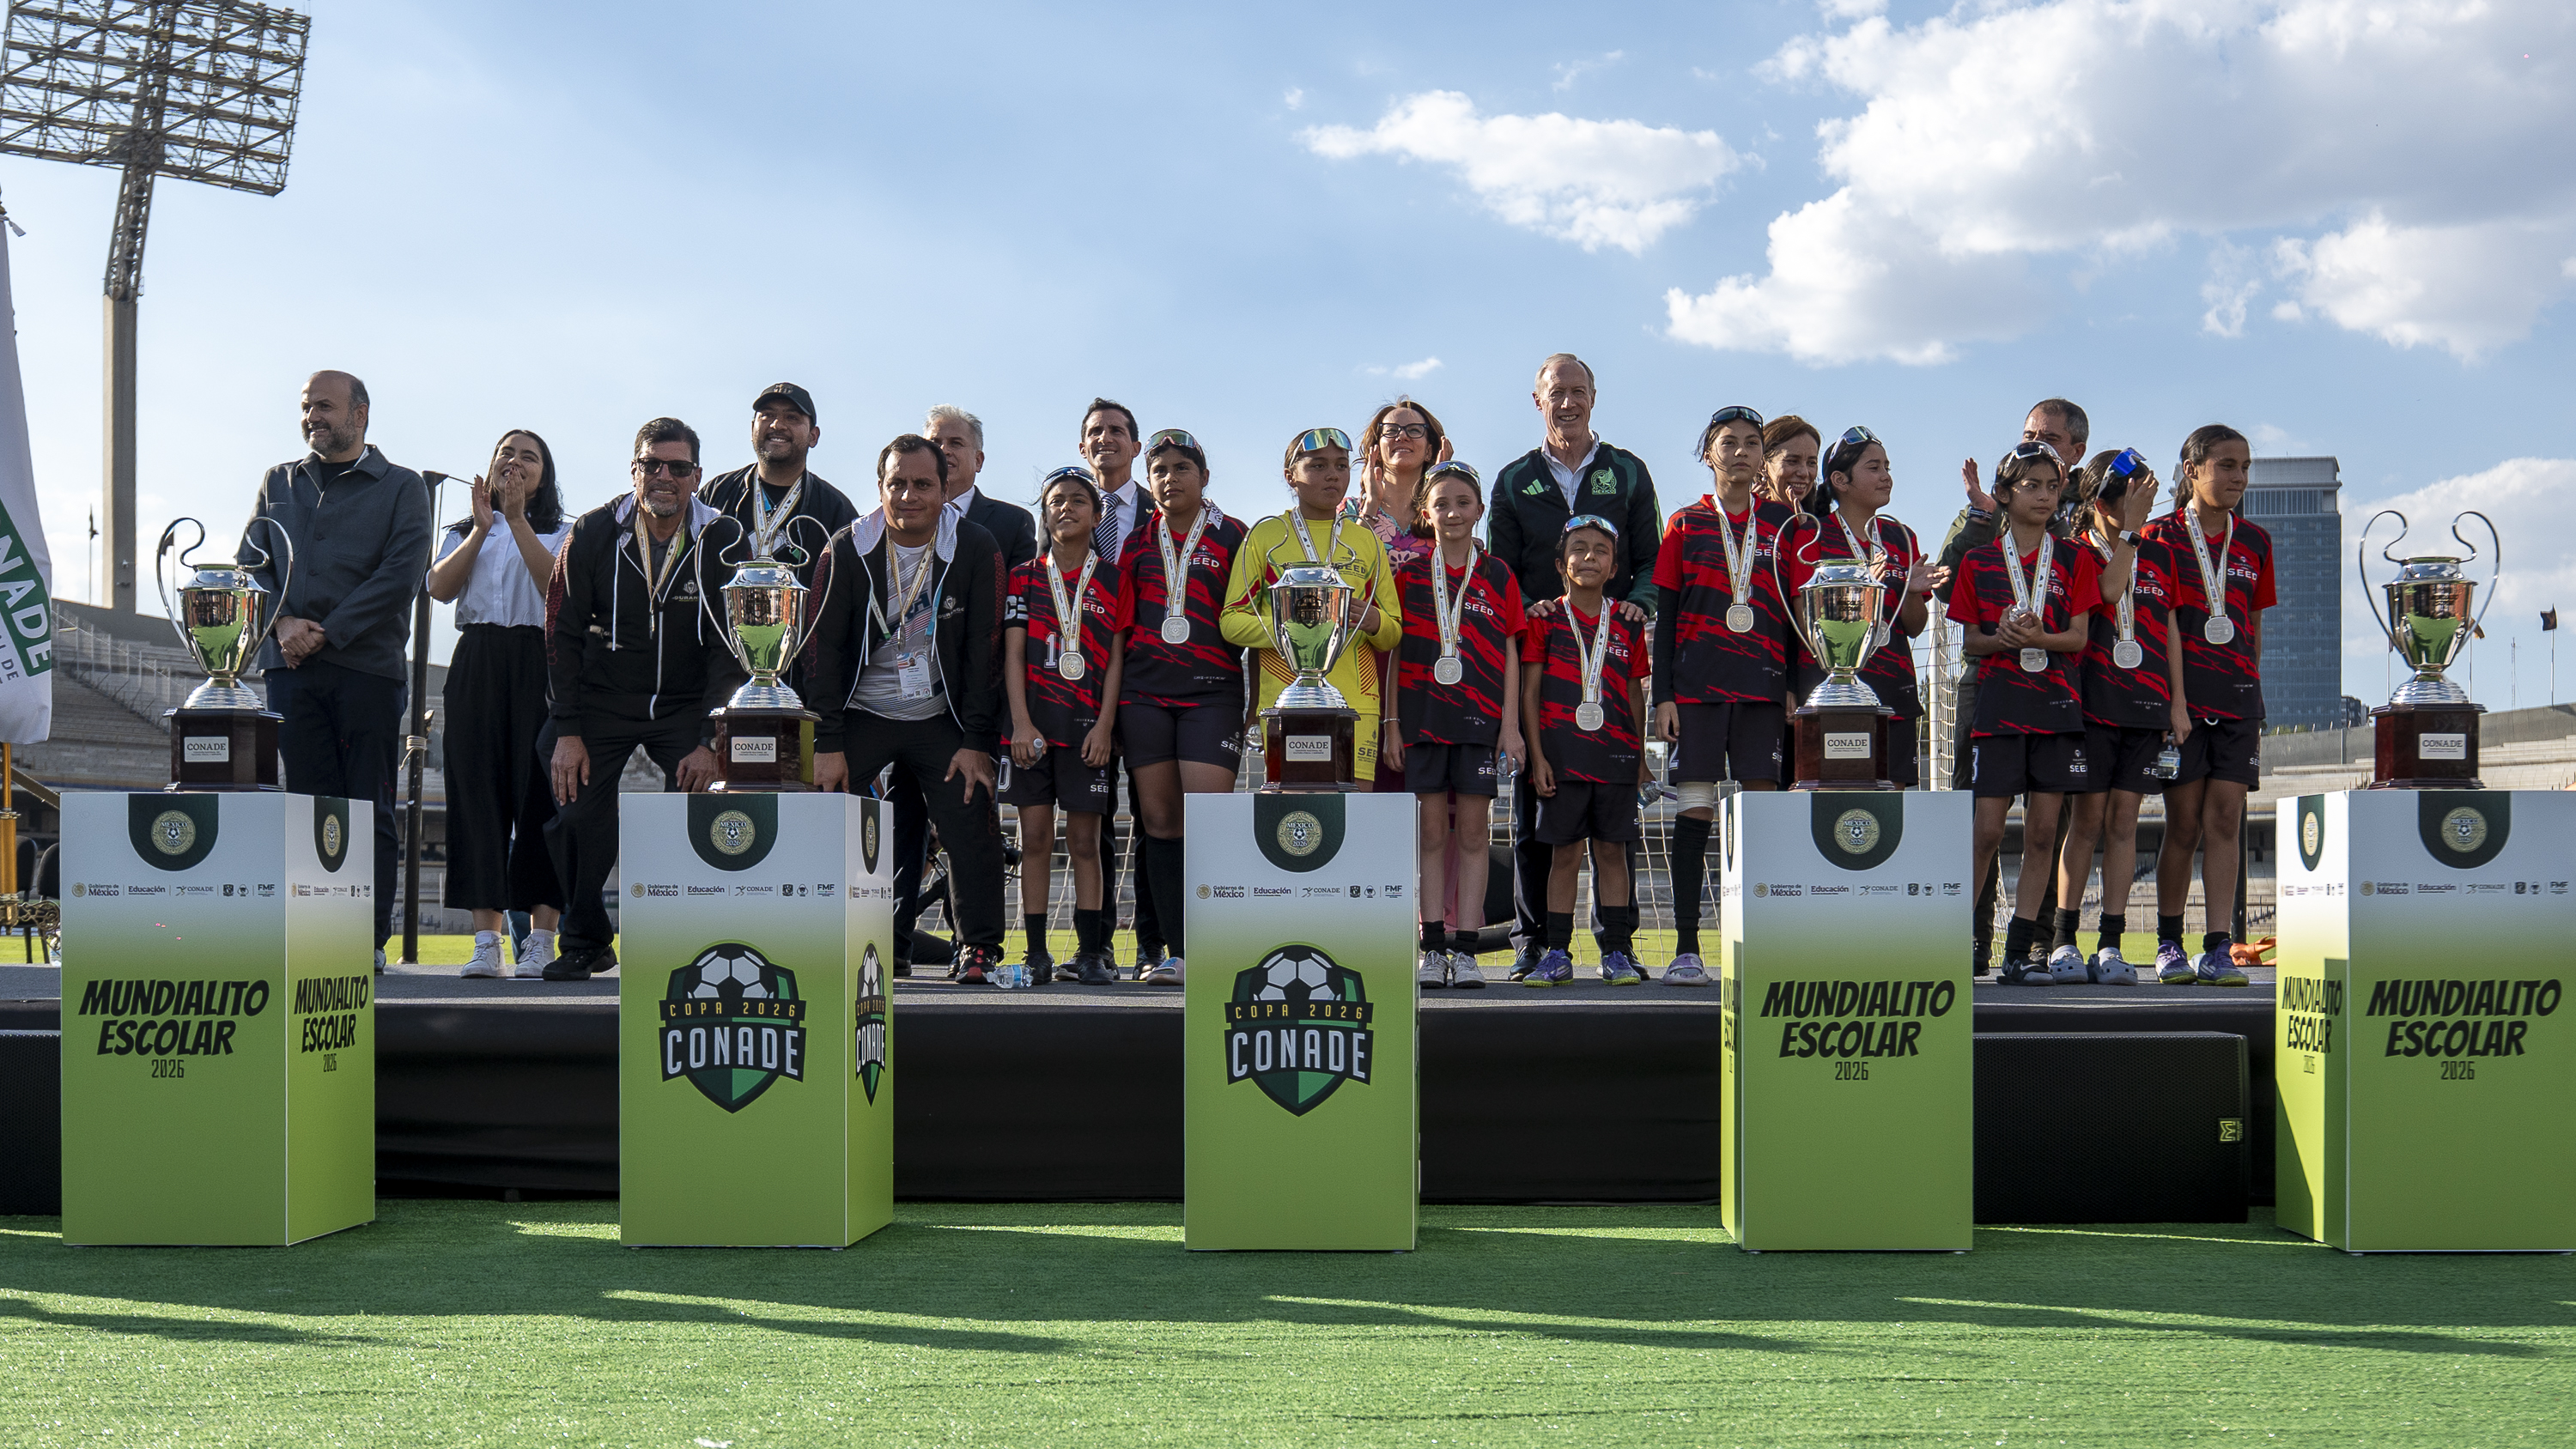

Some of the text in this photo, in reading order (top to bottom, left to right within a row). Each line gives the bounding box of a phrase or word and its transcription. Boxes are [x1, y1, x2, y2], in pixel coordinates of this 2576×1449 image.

[2227, 567, 2257, 580] SEED
[2047, 584, 2064, 596] EED
[2135, 585, 2164, 597] SEED
[1082, 603, 1105, 615] EED
[1464, 602, 1494, 616] SEED
[1358, 747, 1377, 758] SEE
[1091, 785, 1109, 793] SEE
[1213, 889, 1245, 898] México
[2418, 882, 2457, 891] Educación
[78, 979, 270, 1016] MUNDIALITO
[294, 974, 369, 1015] MUNDIALITO
[1760, 980, 1956, 1018] MUNDIALITO
[2366, 979, 2562, 1016] MUNDIALITO
[670, 1002, 795, 1016] COPA 2026
[857, 999, 884, 1016] COPA 2026
[1235, 1004, 1363, 1019] COPA 2026
[96, 1019, 237, 1056] ESCOLAR
[301, 1014, 356, 1054] ESCOLAR
[1779, 1021, 1922, 1058] ESCOLAR
[2385, 1020, 2528, 1058] ESCOLAR
[666, 1027, 799, 1076] CONADE
[856, 1023, 885, 1073] CONADE
[1233, 1029, 1365, 1079] CONADE
[151, 1059, 185, 1078] 2026
[323, 1053, 337, 1073] 2026
[1834, 1061, 1868, 1080] 2026
[2440, 1061, 2475, 1080] 2026
